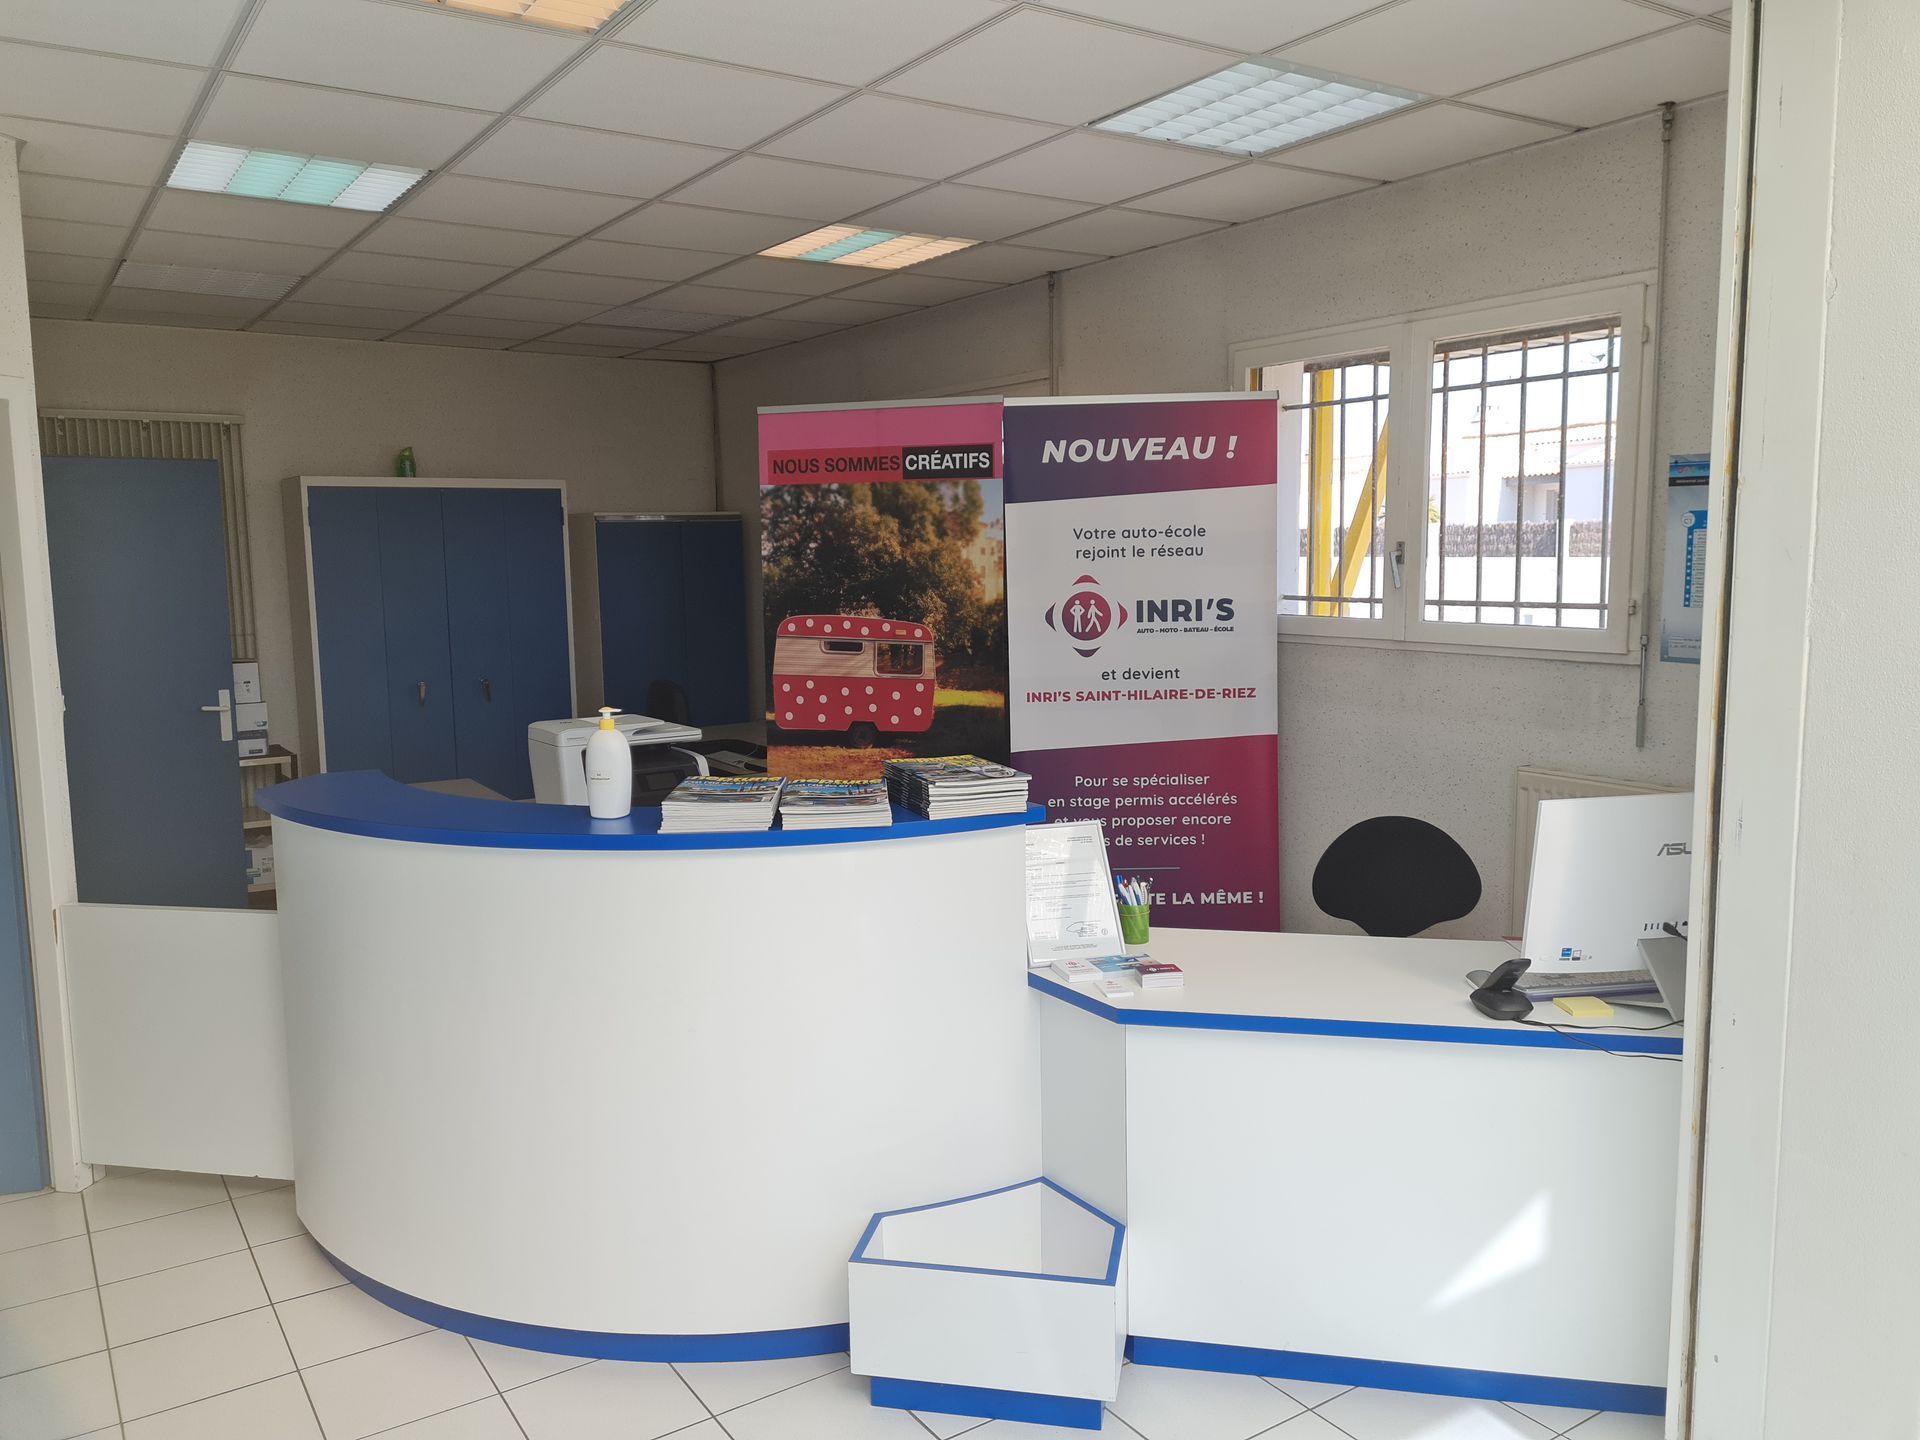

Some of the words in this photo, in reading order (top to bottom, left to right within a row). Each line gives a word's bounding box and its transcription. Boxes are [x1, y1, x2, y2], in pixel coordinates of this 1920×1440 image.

[1041, 435, 1217, 464] NOUVEAU
[1226, 435, 1238, 459] !
[773, 459, 820, 475] NOUS
[824, 455, 901, 473] SOMMES
[905, 449, 991, 471] CRÉATIFS
[1072, 527, 1117, 540] Votre
[1121, 524, 1206, 539] auto-école
[1075, 545, 1127, 562] rejoint
[1132, 544, 1146, 558] le
[1150, 543, 1204, 558] réseau
[1136, 598, 1235, 623] INRI'S
[1101, 669, 1117, 681] et
[1122, 667, 1181, 680] devient
[1026, 690, 1072, 703] INRI'S
[1075, 687, 1257, 702] SAINT-HILAIRE-DE-RIEZ
[1075, 775, 1108, 787] Pour
[1112, 777, 1129, 787] se
[1132, 773, 1210, 789] spécialiser
[1047, 797, 1065, 807] en
[1069, 795, 1111, 810] stage
[1115, 793, 1165, 809] permis
[1168, 792, 1238, 806] accélérés
[1111, 815, 1178, 829] proposer
[1181, 814, 1232, 825] encore
[1115, 834, 1133, 846] de
[1137, 833, 1197, 845] services
[1201, 833, 1205, 845] !
[1656, 842, 1692, 857] ASU
[1172, 892, 1195, 905] LA
[1200, 888, 1254, 905] MÊME
[1258, 891, 1265, 904] !
